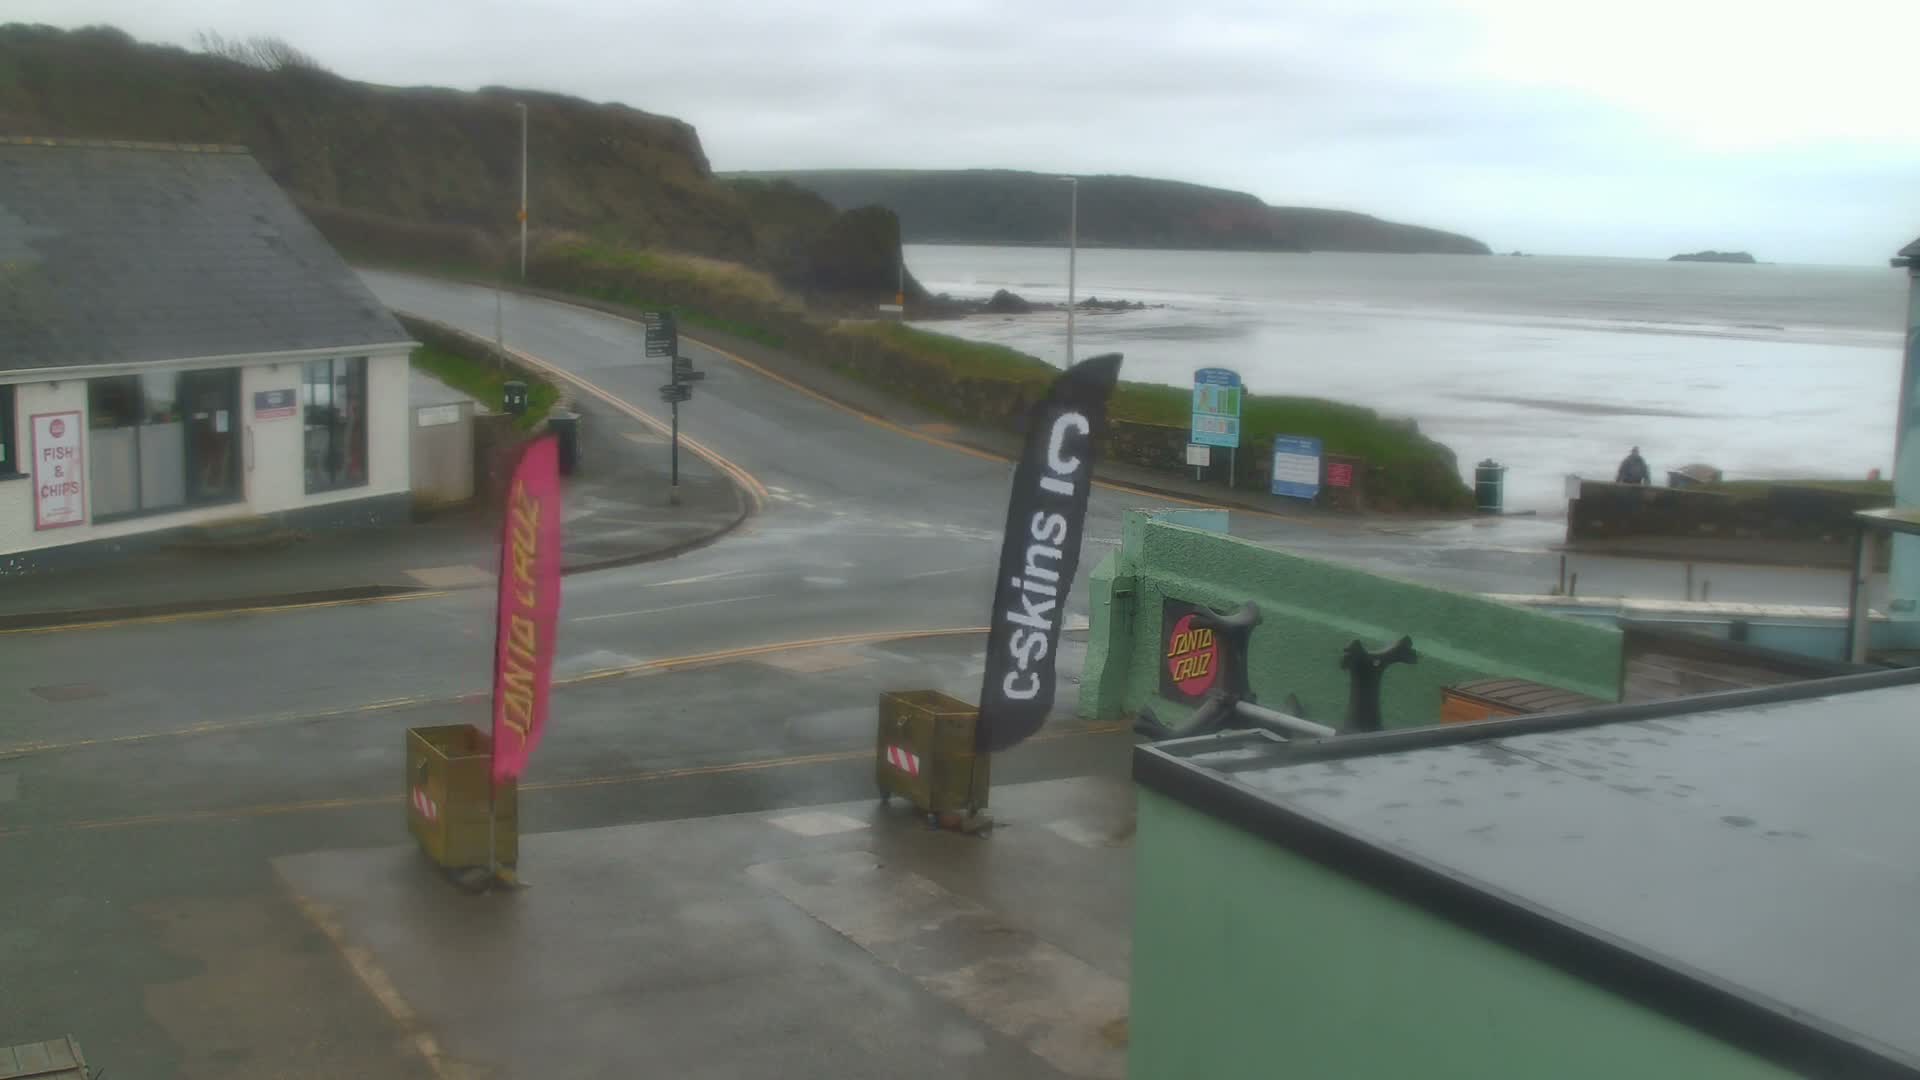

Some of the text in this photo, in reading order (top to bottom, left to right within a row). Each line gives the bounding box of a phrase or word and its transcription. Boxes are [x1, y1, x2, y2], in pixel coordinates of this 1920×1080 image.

[43, 446, 74, 461] FISH
[54, 465, 65, 478] &
[41, 481, 80, 498] CHIPS
[1167, 628, 1214, 657] SANTA
[1173, 653, 1213, 682] CRUZ
[503, 615, 537, 751] SANTA
